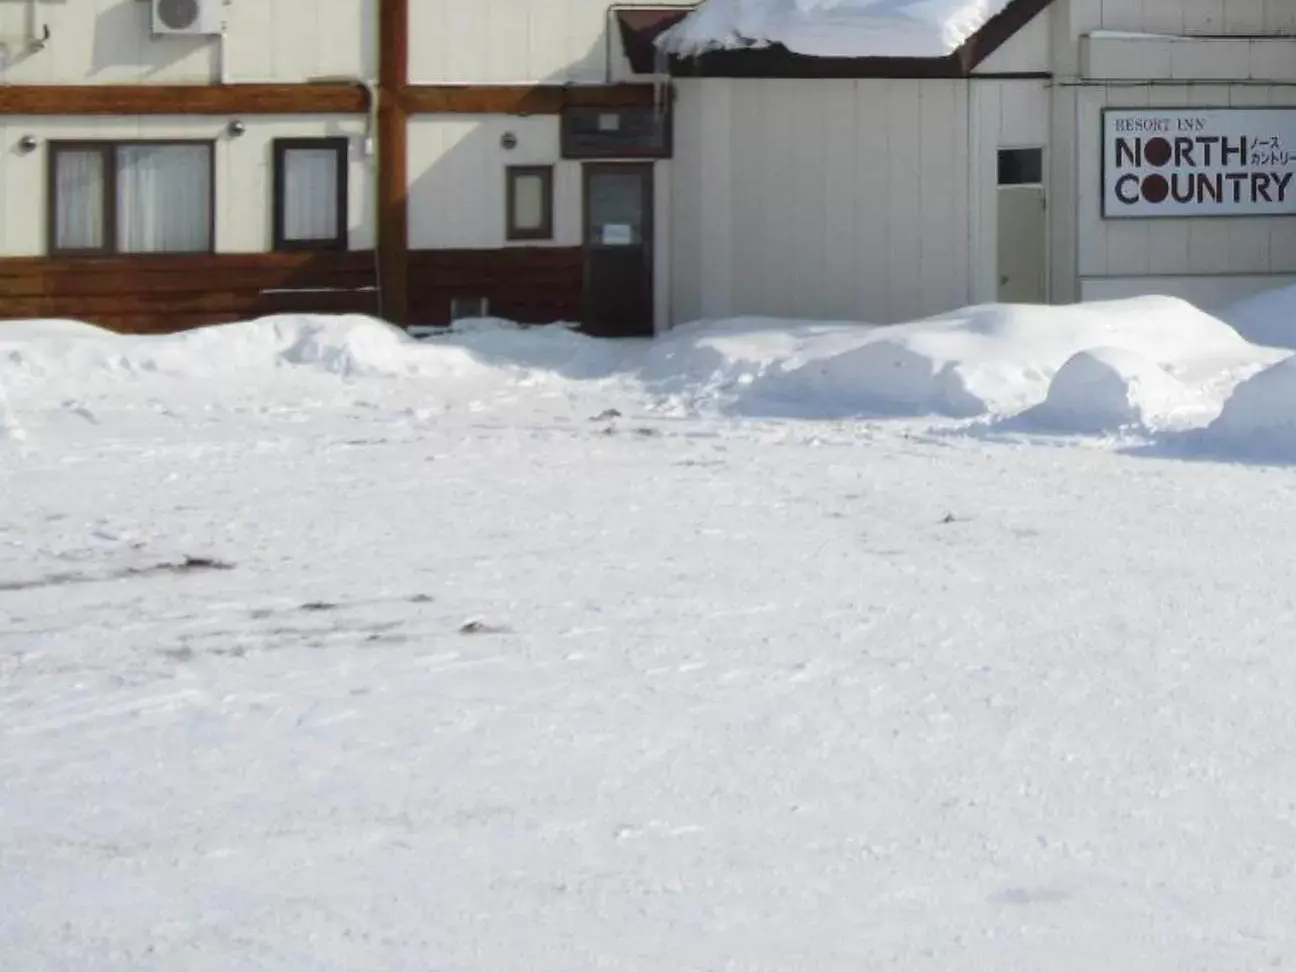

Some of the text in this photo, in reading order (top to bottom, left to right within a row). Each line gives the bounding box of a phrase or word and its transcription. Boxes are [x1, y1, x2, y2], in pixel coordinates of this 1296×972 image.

[1115, 118, 1205, 132] RESORT INN
[1115, 136, 1246, 168] NORTH
[1251, 136, 1280, 149] ノース
[1115, 172, 1293, 205] COUNTRY
